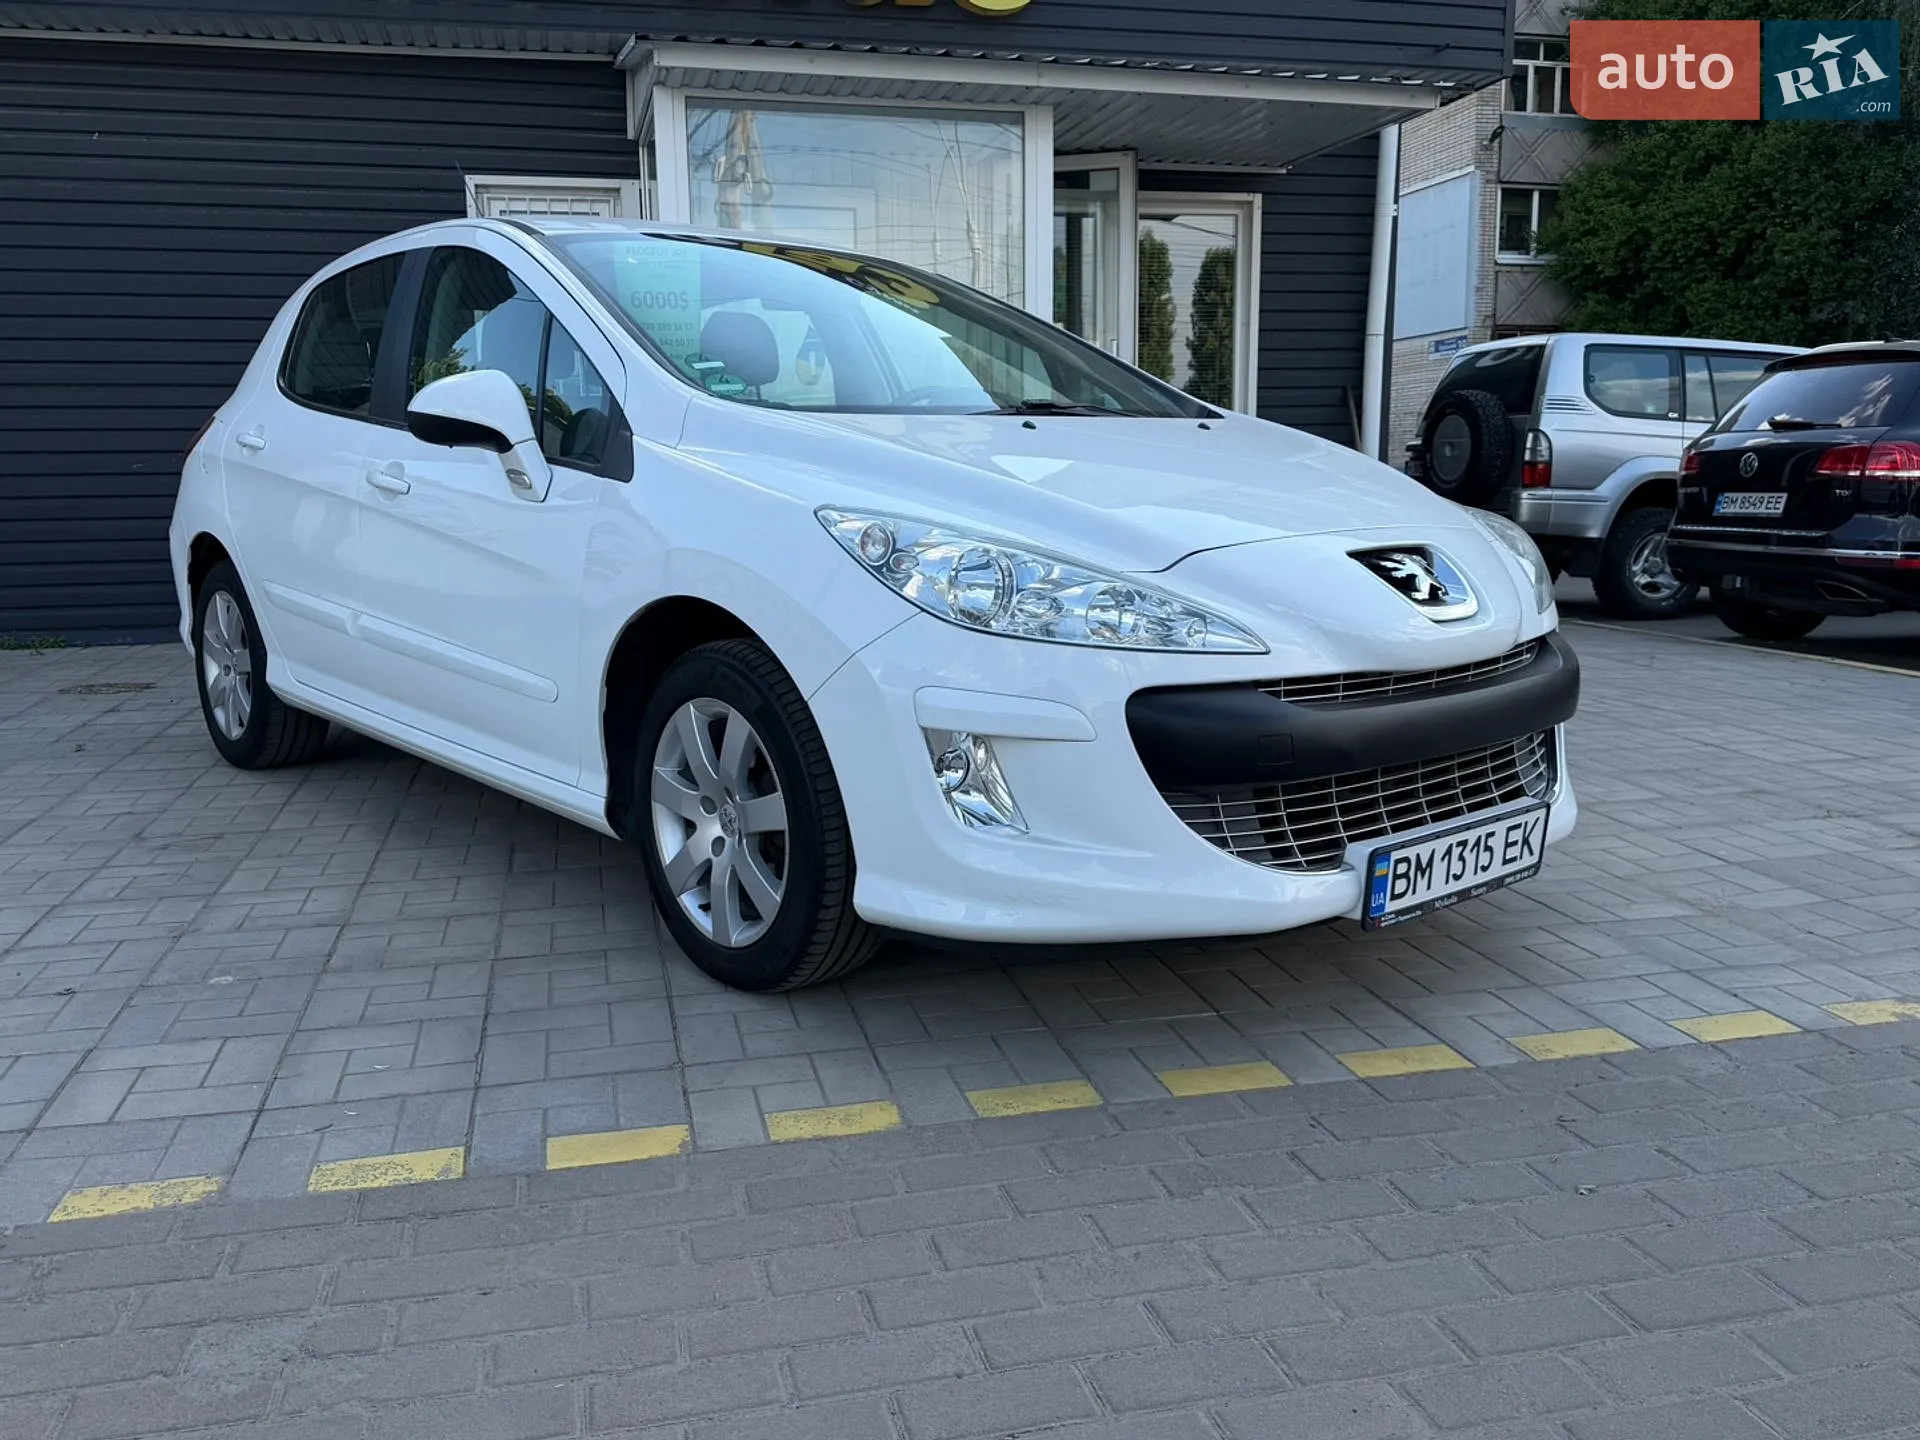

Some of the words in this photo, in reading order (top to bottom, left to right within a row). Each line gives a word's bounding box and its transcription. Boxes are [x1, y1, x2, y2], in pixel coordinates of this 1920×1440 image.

[630, 289, 690, 313] 6000$
[1765, 495, 1784, 510] EE
[1390, 847, 1435, 901] BM
[1440, 830, 1496, 886] 1315
[1501, 815, 1540, 866] EK
[1371, 891, 1385, 907] UA
